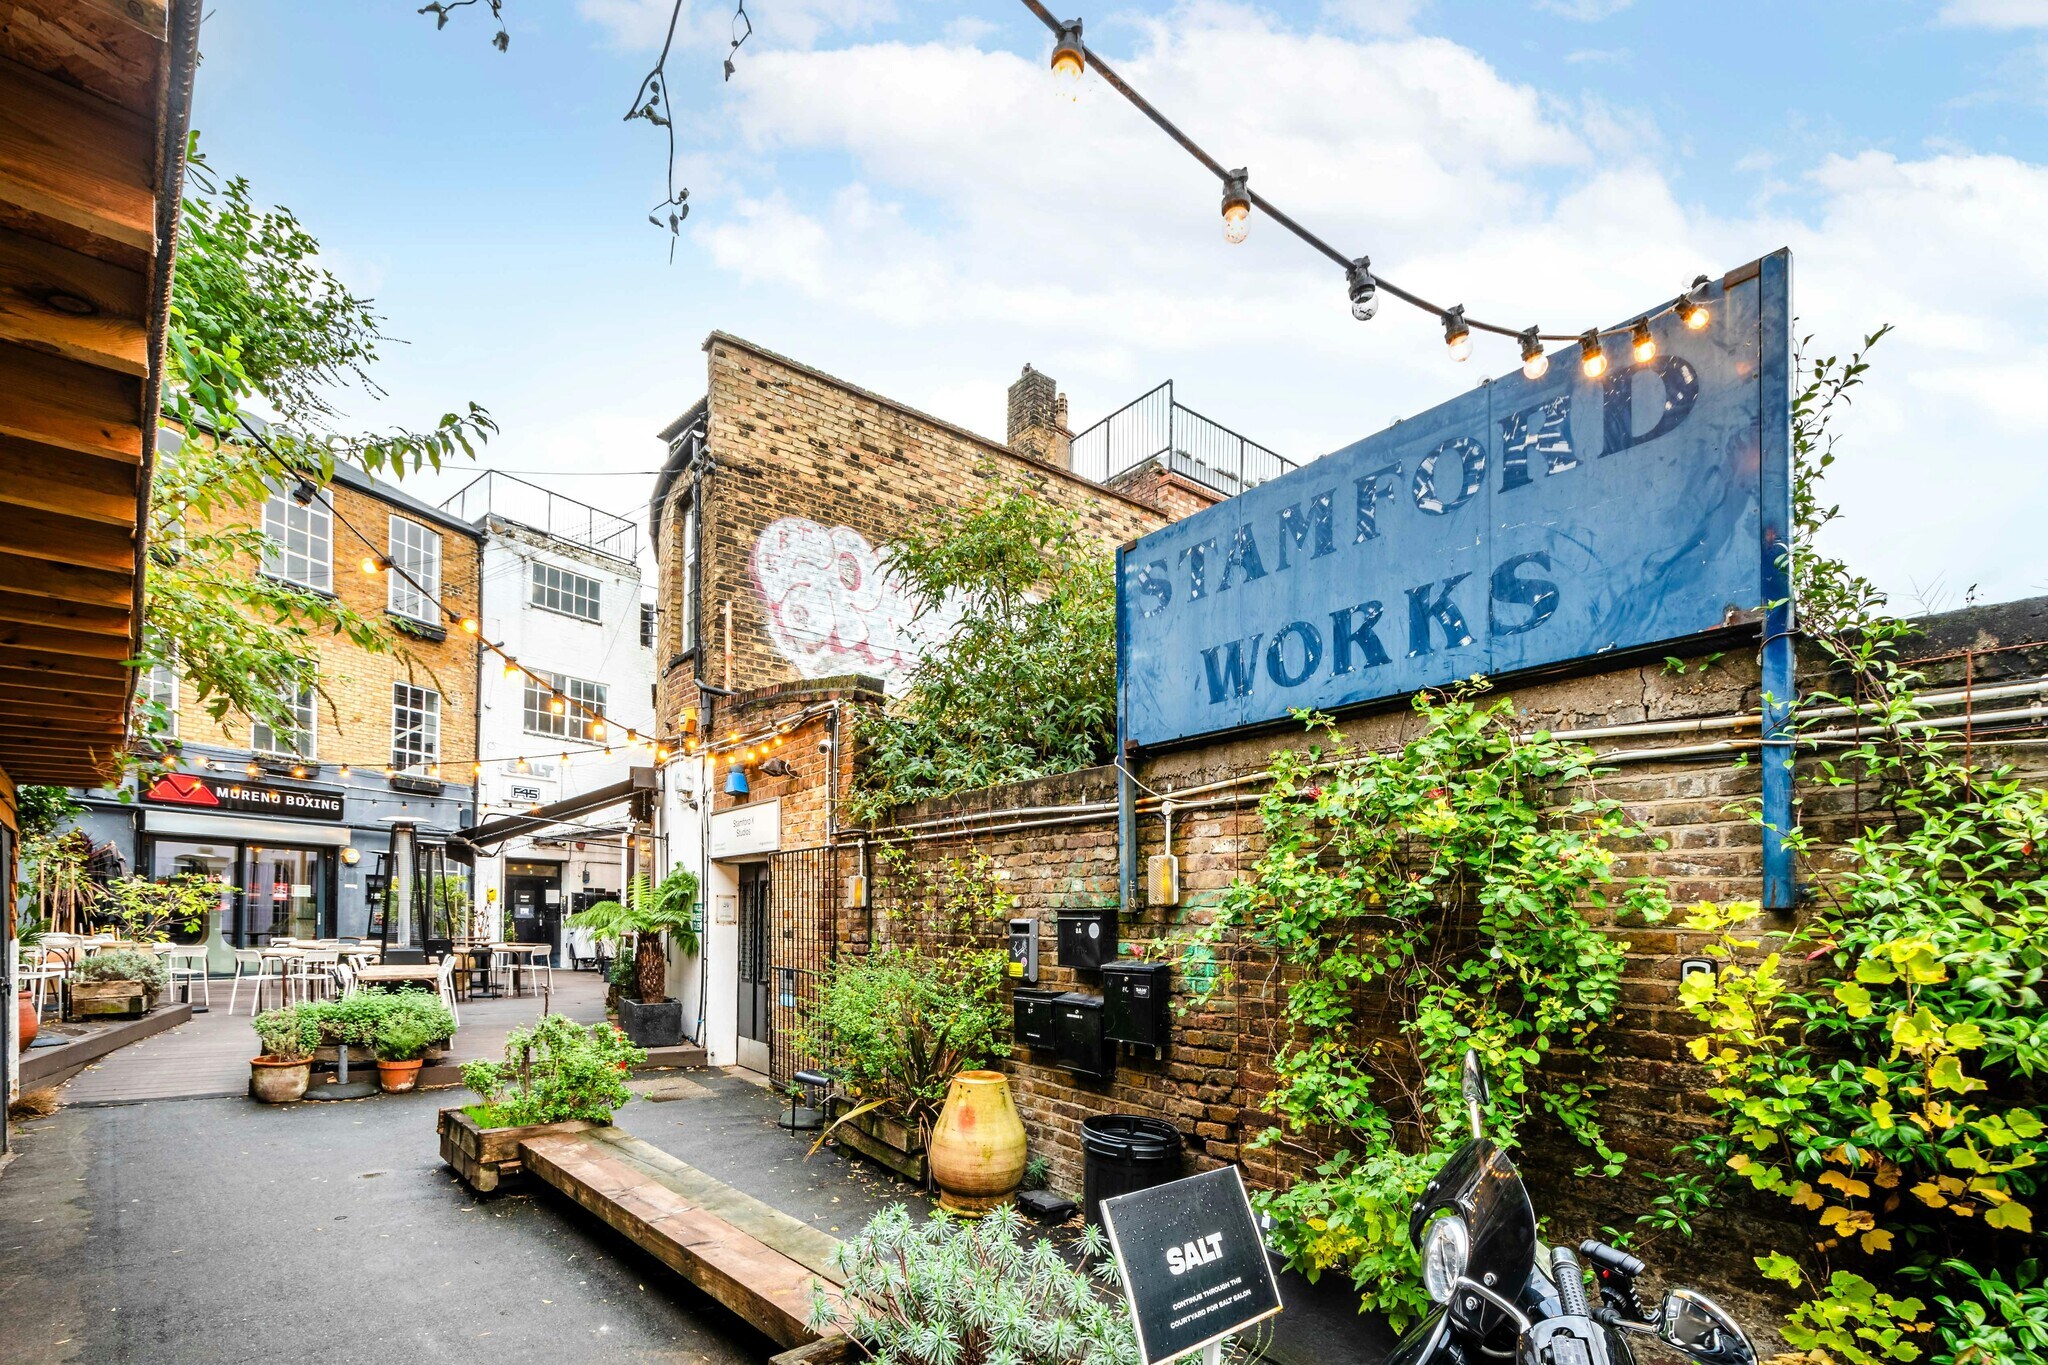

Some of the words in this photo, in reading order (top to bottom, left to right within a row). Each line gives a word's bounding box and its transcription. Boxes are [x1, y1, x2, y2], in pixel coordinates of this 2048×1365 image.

[1137, 355, 1699, 618] STAMFORD
[1200, 550, 1560, 705] WORKS
[216, 786, 280, 804] MORENO
[286, 795, 340, 811] BOXING
[512, 786, 539, 799] F45
[1166, 1231, 1223, 1276] SALT
[1170, 1308, 1206, 1329] COURTYARD
[1206, 1303, 1219, 1313] FOR
[1219, 1297, 1233, 1308] SALT
[1232, 1288, 1252, 1302] SALON
[1173, 1292, 1203, 1310] CONTINUE
[1203, 1281, 1230, 1297] THROUGH
[1230, 1276, 1242, 1287] THE
